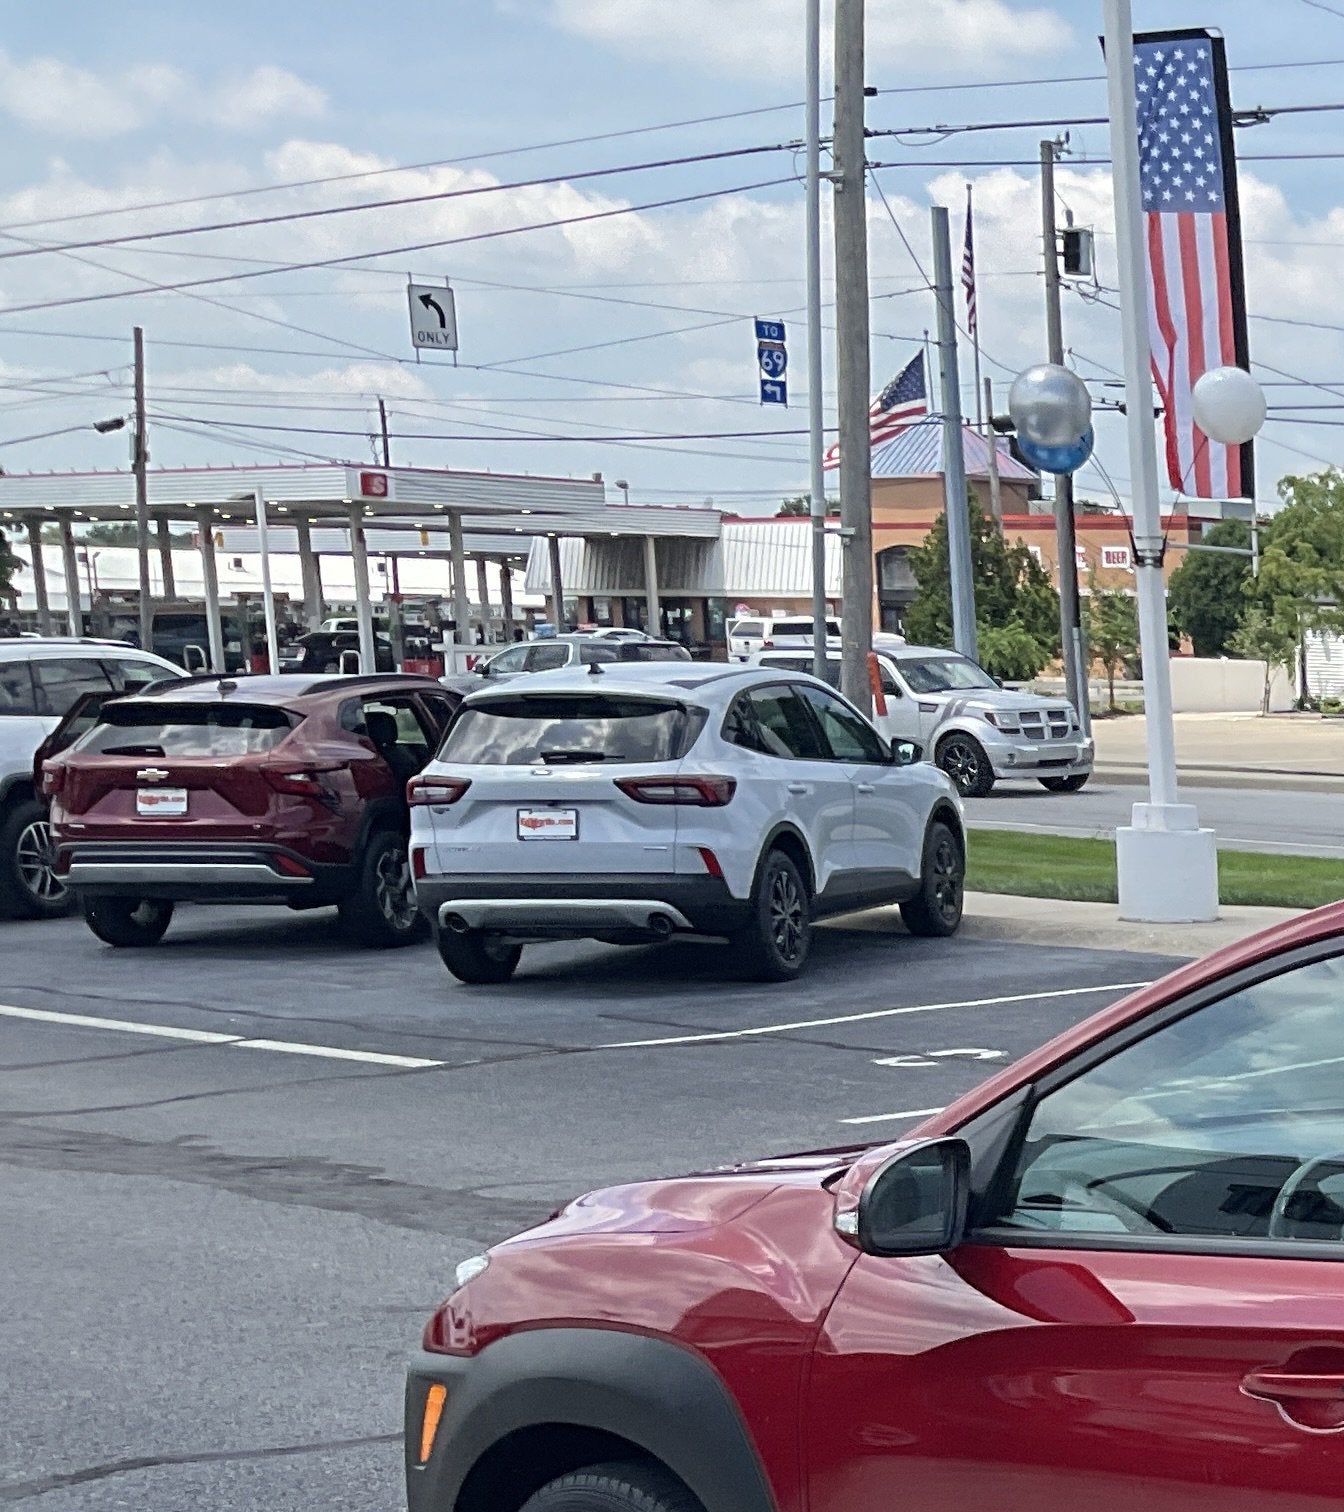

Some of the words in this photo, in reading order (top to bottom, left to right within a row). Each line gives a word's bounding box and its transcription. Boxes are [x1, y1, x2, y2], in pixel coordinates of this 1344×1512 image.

[763, 325, 778, 337] TO
[417, 331, 450, 345] ONLY
[761, 350, 785, 371] 69
[1104, 551, 1127, 564] BEER
